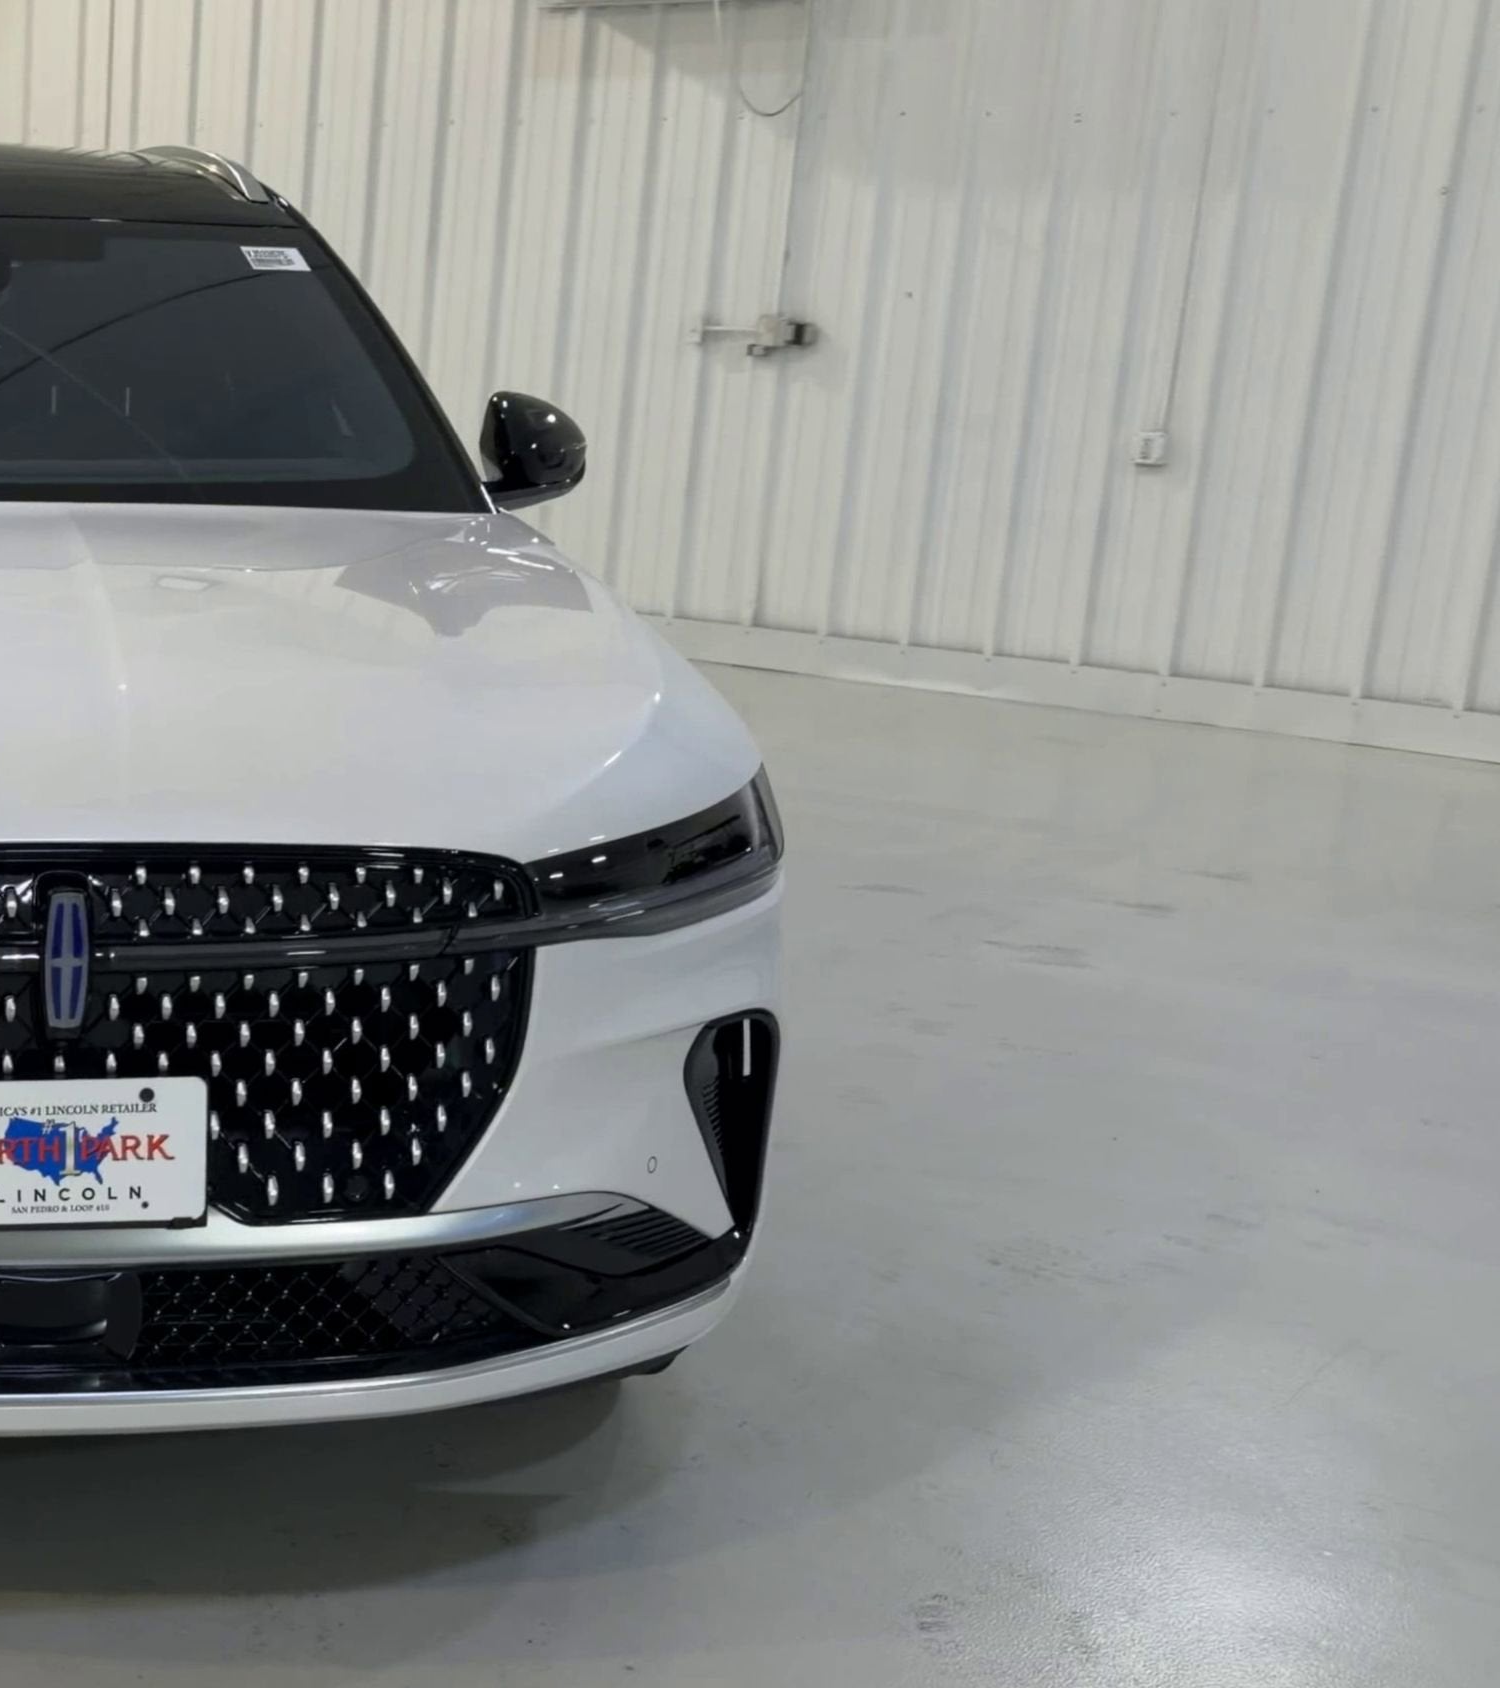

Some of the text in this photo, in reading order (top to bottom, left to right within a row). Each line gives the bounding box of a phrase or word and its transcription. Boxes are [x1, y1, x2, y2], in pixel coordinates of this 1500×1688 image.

[30, 1105, 42, 1116] #1
[45, 1104, 99, 1116] LINCOLN
[101, 1103, 157, 1114] RETAILER
[81, 1134, 175, 1161] PARK
[11, 1205, 29, 1214] SAN
[30, 1204, 59, 1214] PEDRO
[61, 1205, 68, 1213] &
[70, 1203, 94, 1212] LOOP
